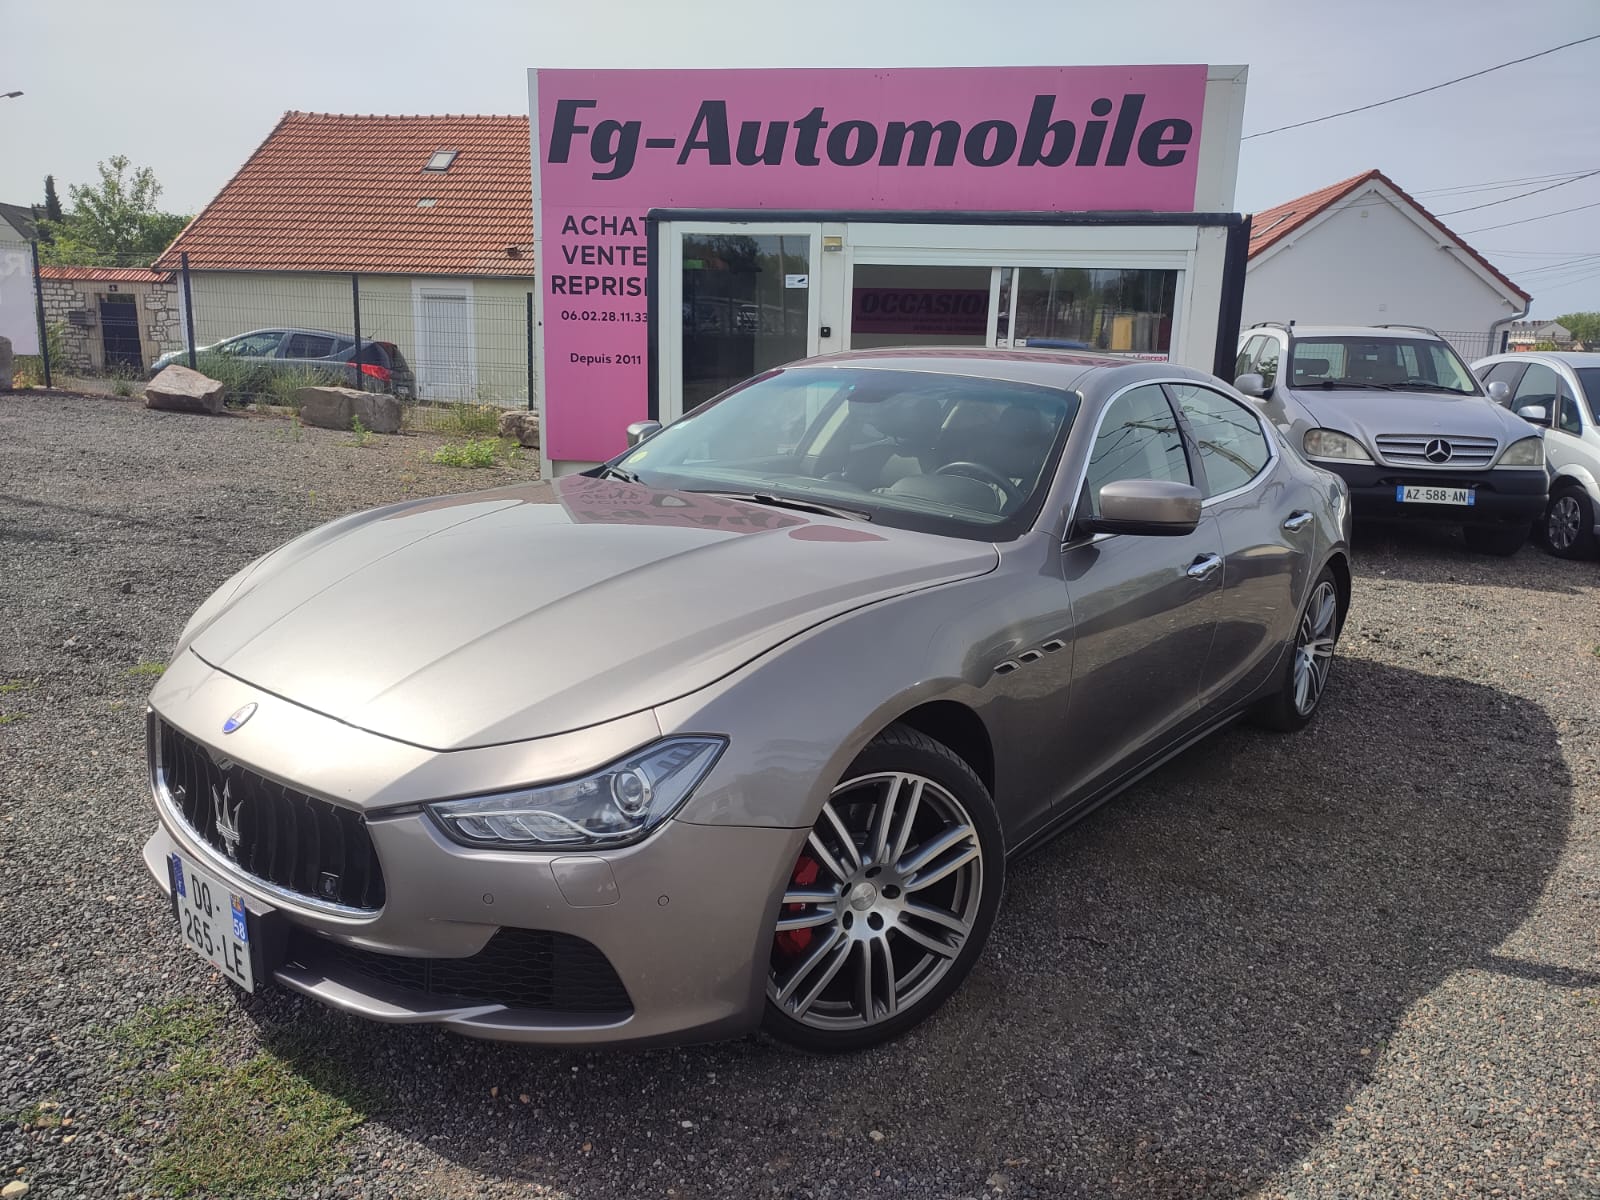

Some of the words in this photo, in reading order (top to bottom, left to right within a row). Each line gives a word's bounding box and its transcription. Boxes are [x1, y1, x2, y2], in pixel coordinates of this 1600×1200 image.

[548, 94, 1193, 181] Fg-Automobile
[562, 245, 648, 266] VENTE
[552, 275, 648, 297] REPRIS
[861, 293, 989, 314] OCCASIO
[561, 310, 648, 323] 06.02.28.11.33
[570, 353, 612, 366] Depuis
[615, 354, 641, 365] 2011
[233, 918, 246, 940] 58
